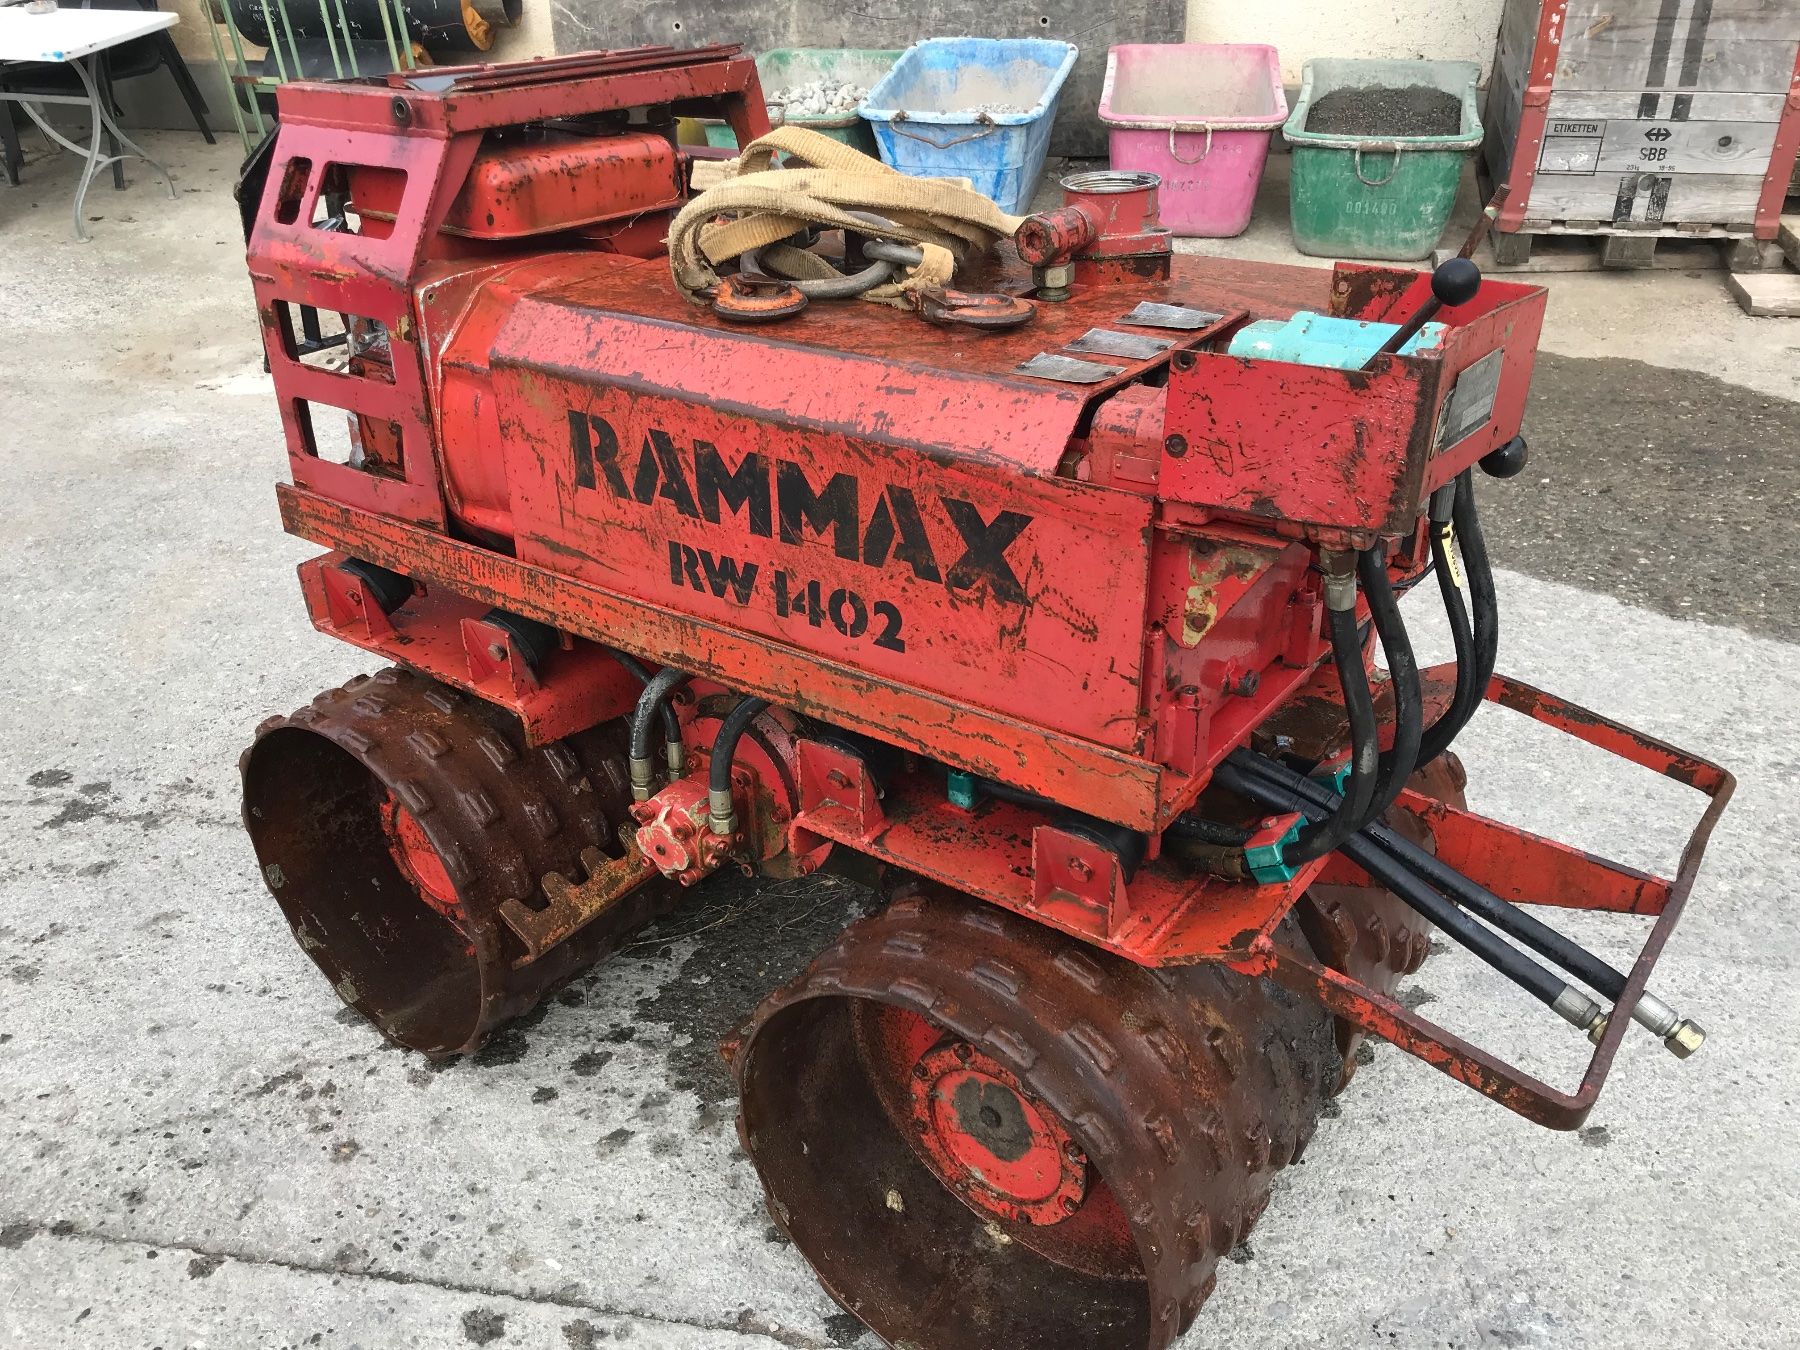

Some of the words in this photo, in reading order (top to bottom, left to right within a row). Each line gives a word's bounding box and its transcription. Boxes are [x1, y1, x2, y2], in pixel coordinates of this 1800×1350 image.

[1553, 123, 1598, 134] ETIKETTEN
[1639, 147, 1667, 161] SBB
[567, 409, 1033, 607] RAMMAX
[668, 540, 759, 606] RW
[775, 570, 906, 654] 1402
